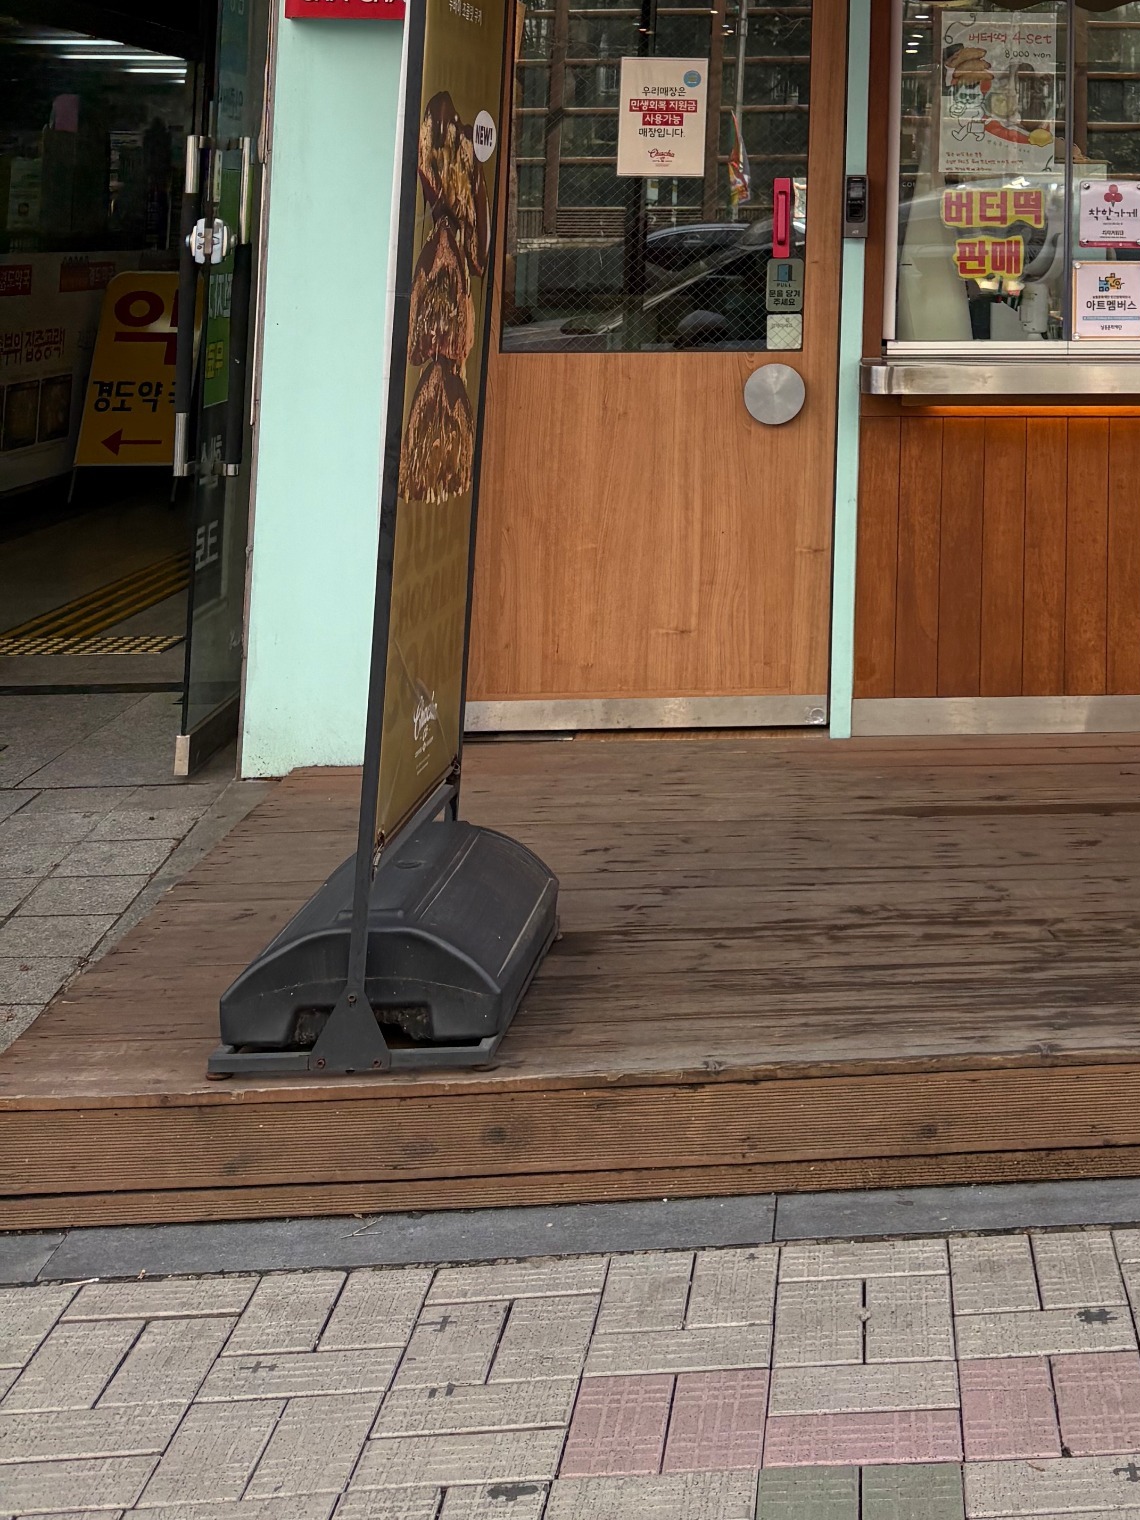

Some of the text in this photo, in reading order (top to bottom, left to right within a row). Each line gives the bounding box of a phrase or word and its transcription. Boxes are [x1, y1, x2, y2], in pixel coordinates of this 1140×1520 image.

[642, 86, 687, 97] 우리매장은
[630, 101, 697, 112] 민생회복 지원금
[644, 113, 682, 126] 사용가능
[475, 124, 494, 148] NEW!
[944, 190, 1042, 226] 버터떡
[956, 240, 1021, 276] 판매
[1086, 300, 1138, 311] 아트멤버스
